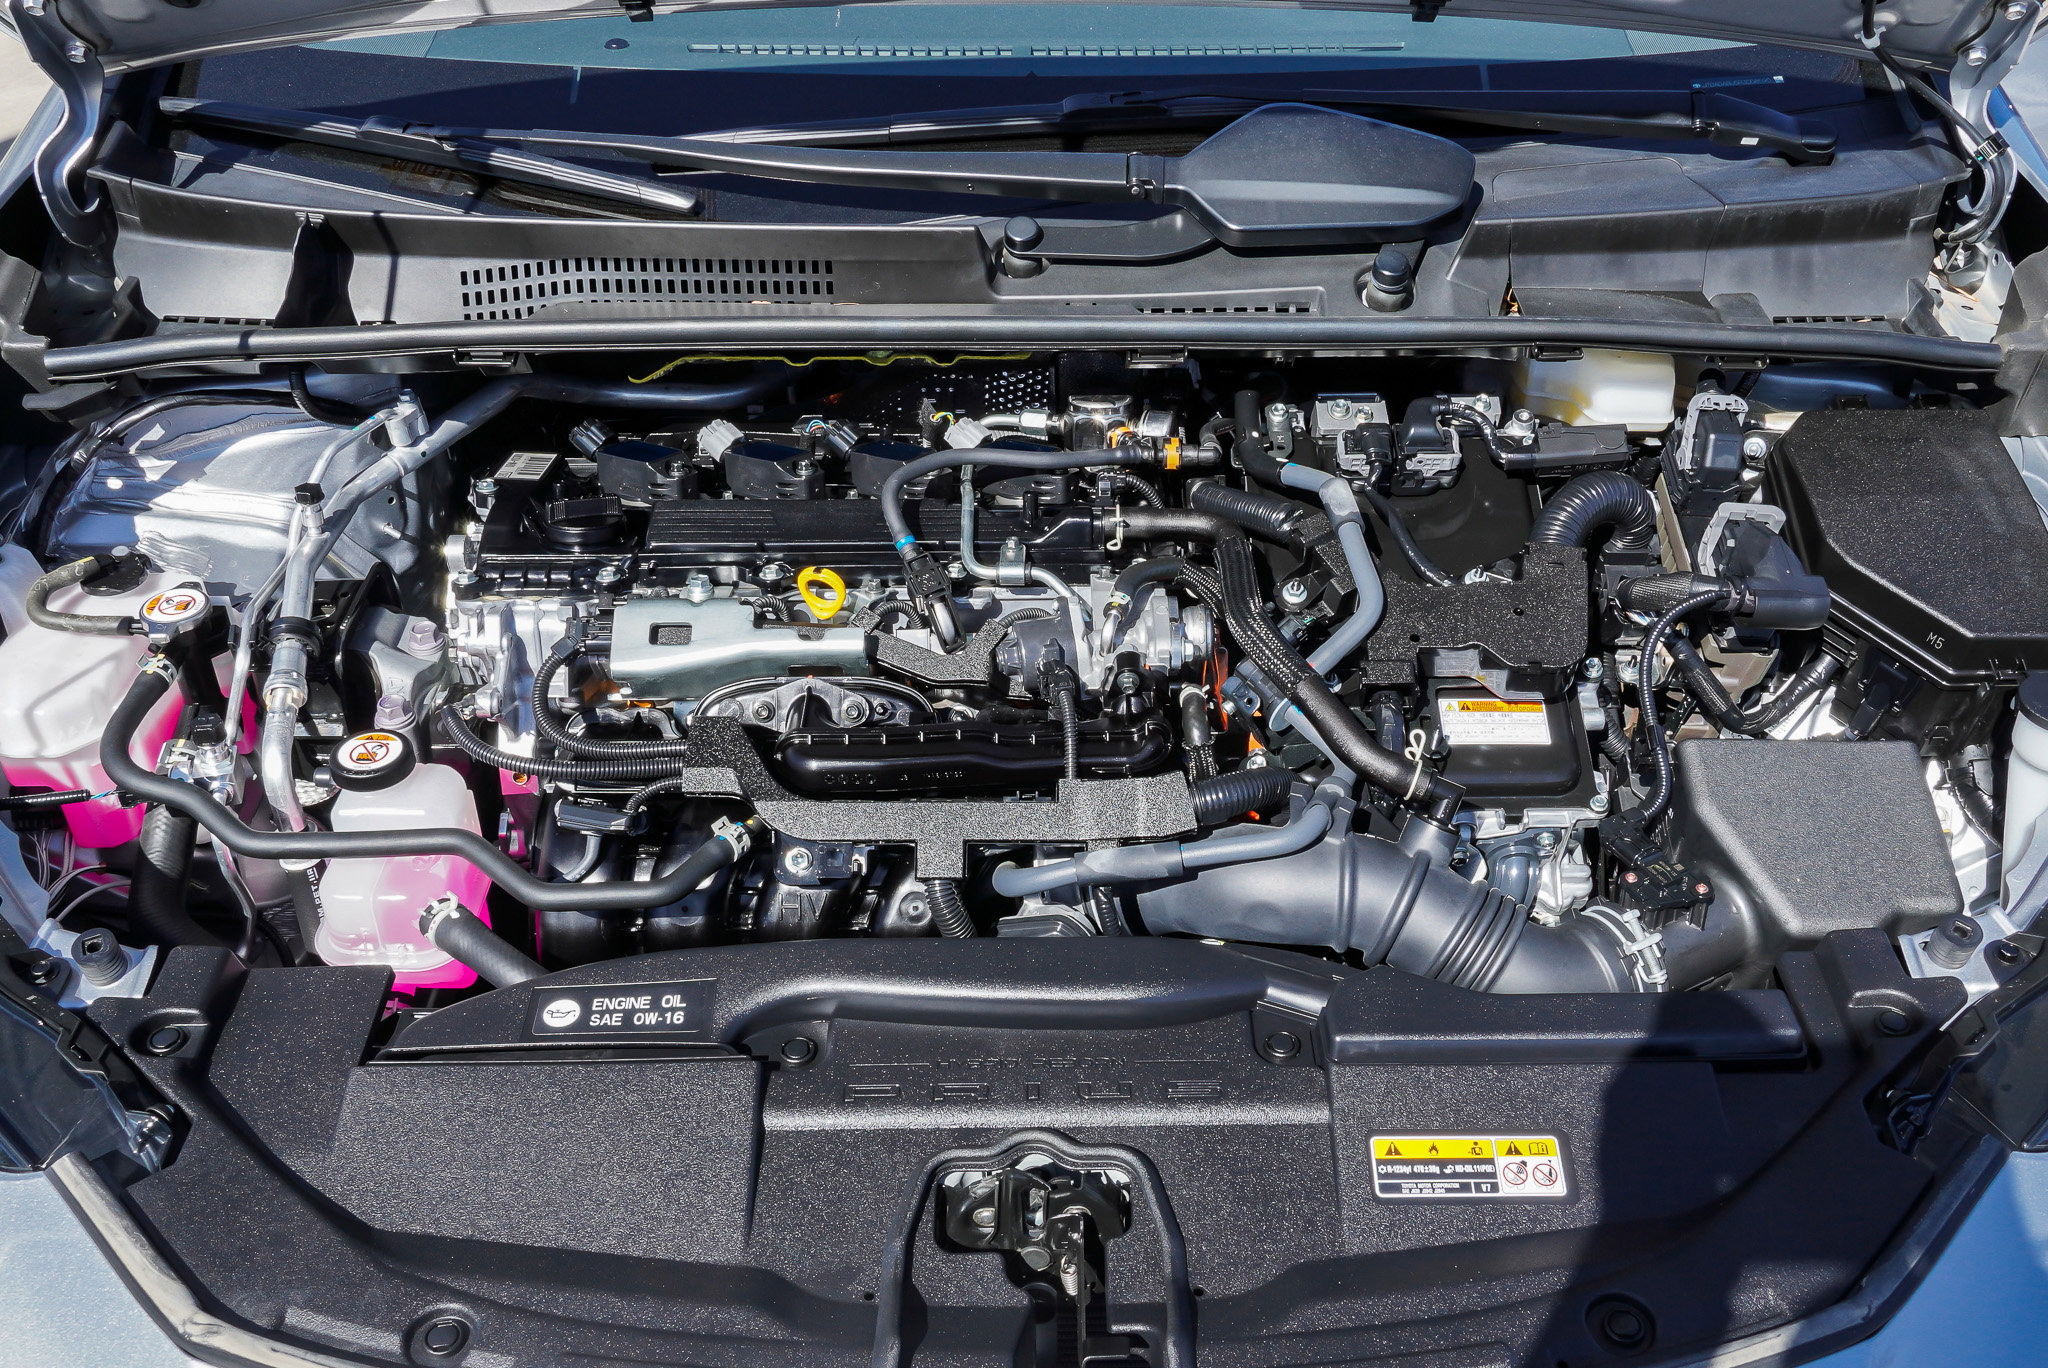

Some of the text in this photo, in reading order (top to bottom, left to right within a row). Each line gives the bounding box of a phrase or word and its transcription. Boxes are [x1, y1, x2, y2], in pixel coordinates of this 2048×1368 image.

[1925, 631, 1946, 650] M5
[778, 892, 829, 921] HV
[592, 995, 687, 1011] ENGINE OIL
[589, 1011, 685, 1027] SAE 0W-16
[1481, 1183, 1491, 1192] V7
